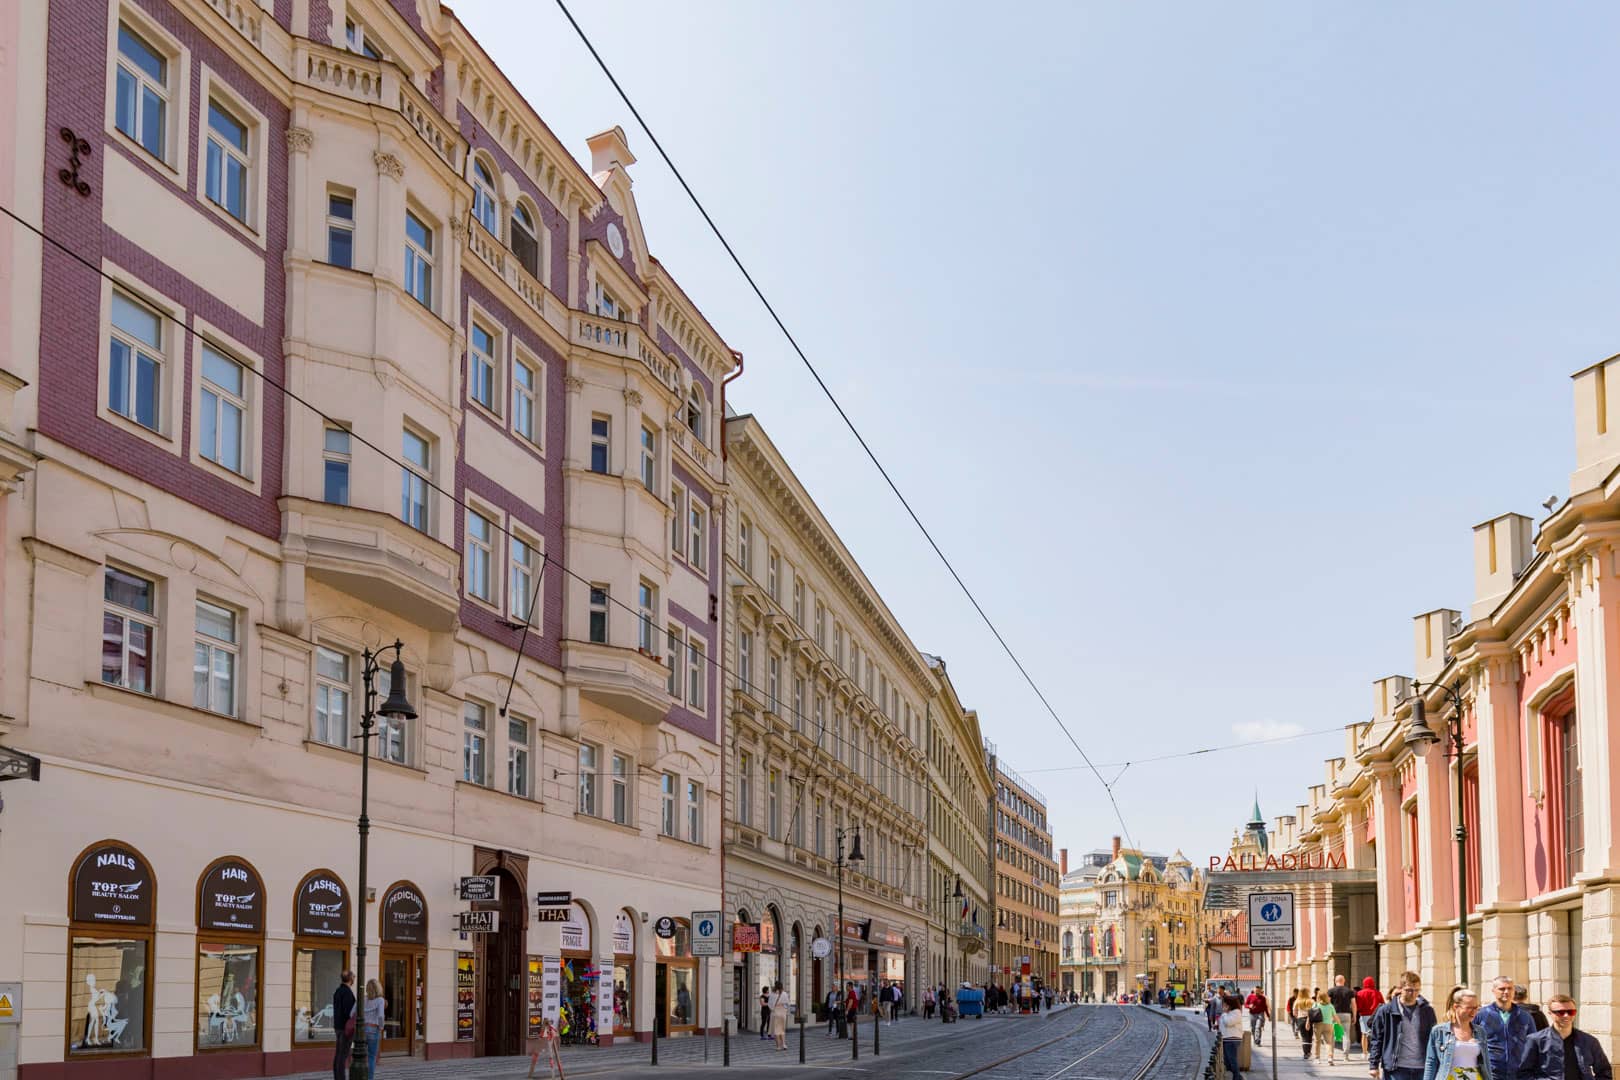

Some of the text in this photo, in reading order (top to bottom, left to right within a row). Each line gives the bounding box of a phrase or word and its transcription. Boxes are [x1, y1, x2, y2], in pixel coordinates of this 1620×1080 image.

[97, 854, 136, 871] NAILS
[1209, 852, 1347, 871] PALLADIUM
[222, 868, 248, 883] HAIR
[91, 882, 118, 892] TOP
[309, 880, 341, 897] LASHES
[215, 893, 236, 903] TOP
[389, 890, 424, 910] PEDICURE
[309, 903, 327, 912] TOP
[462, 912, 492, 924] THAI
[539, 909, 570, 921] THAI
[562, 935, 582, 947] PRAGUE
